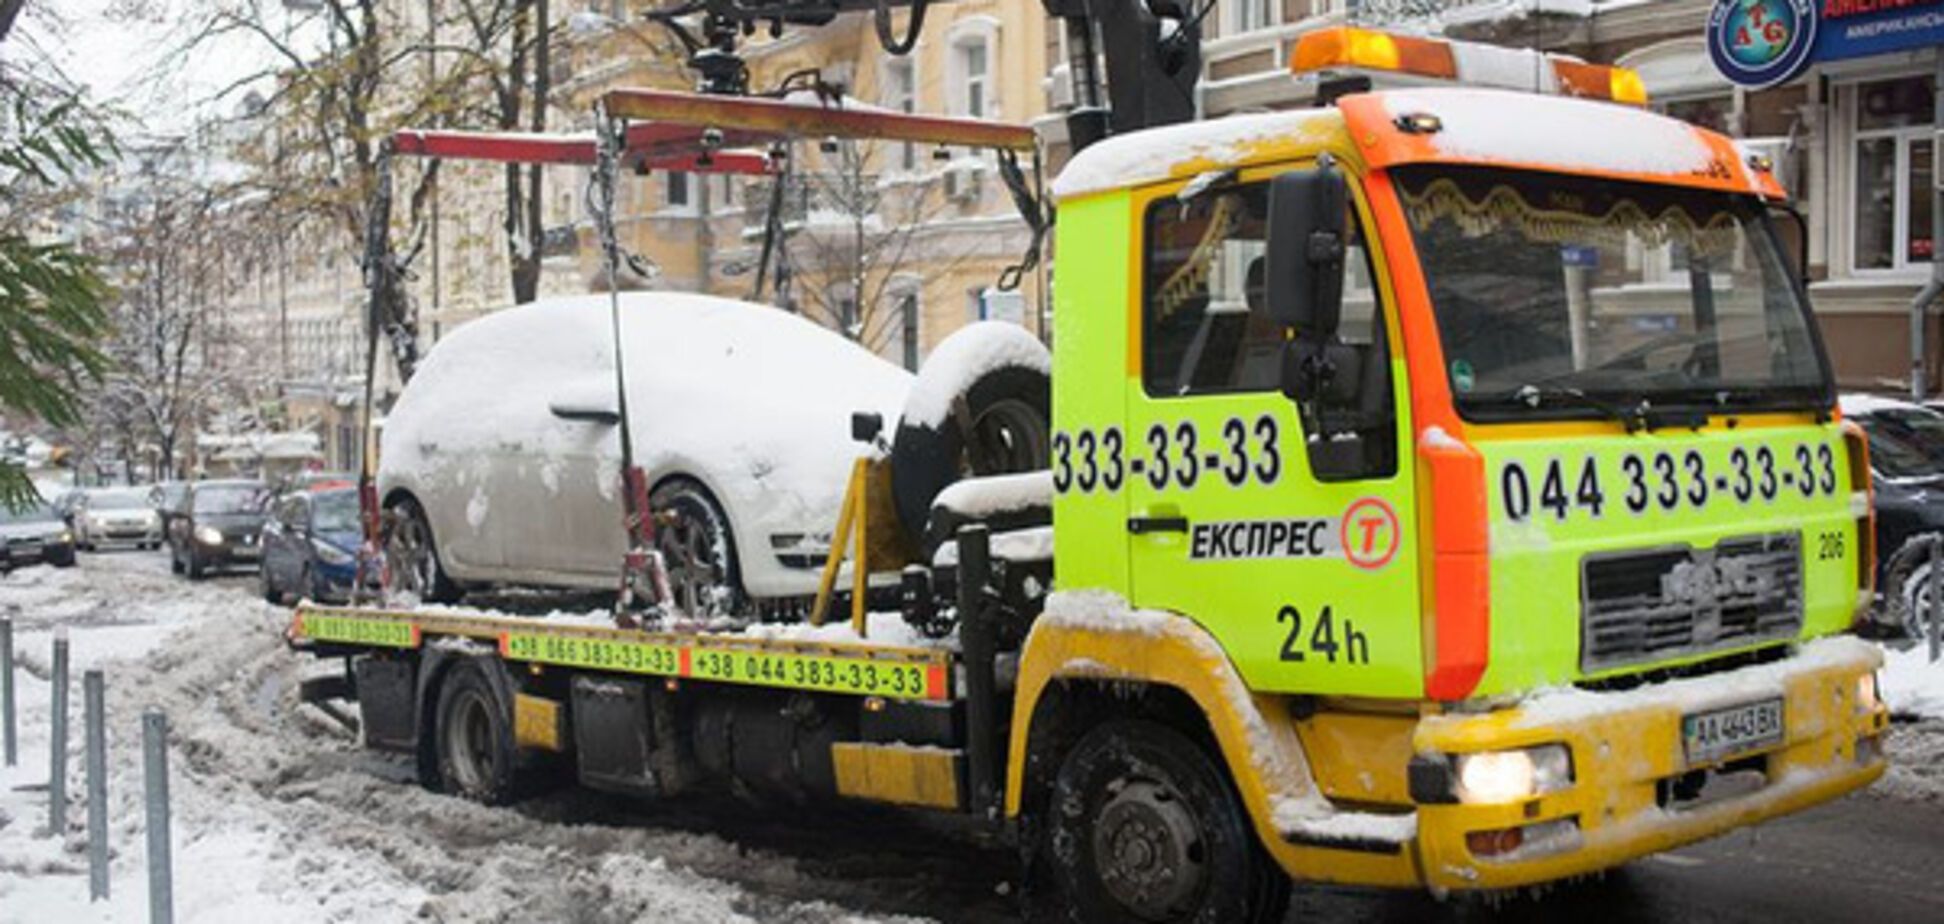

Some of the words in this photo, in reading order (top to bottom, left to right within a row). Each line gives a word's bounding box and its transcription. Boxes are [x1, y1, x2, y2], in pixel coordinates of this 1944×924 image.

[1052, 415, 1281, 493] 333-33-33
[1502, 456, 1604, 522] 044
[1623, 443, 1836, 513] 333-33-33
[1190, 521, 1327, 559] ЕКСПРЕС
[696, 653, 734, 676] +38
[745, 657, 786, 681] 044
[794, 660, 923, 695] 383-33-33
